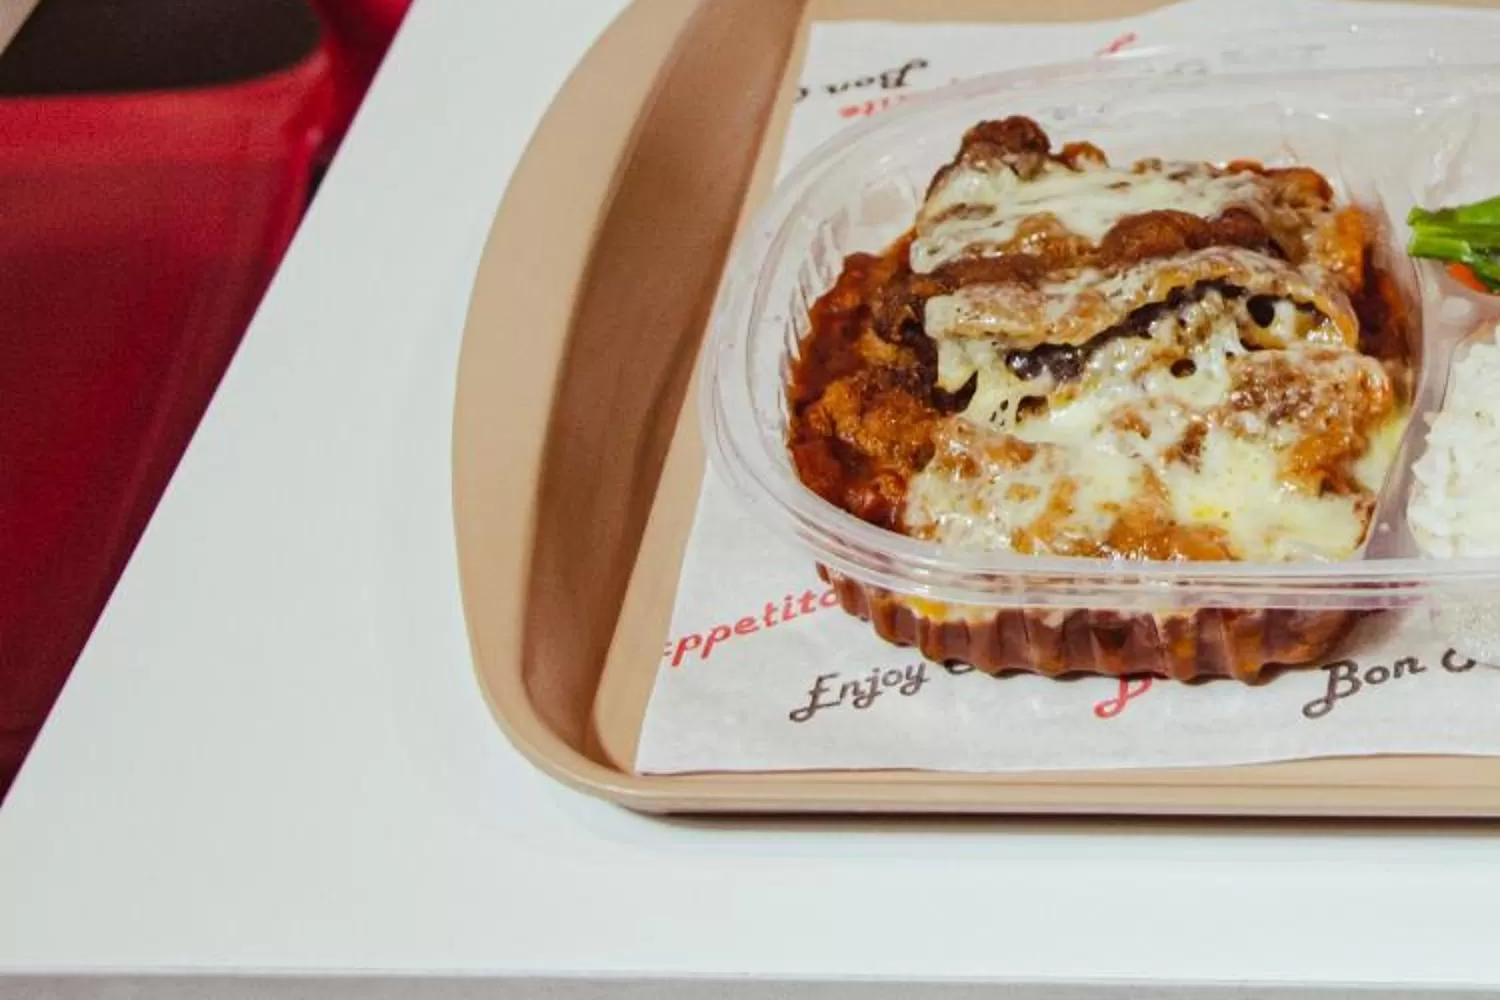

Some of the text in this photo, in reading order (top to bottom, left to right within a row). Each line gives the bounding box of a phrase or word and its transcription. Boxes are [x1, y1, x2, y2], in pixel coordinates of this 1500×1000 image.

[663, 588, 840, 668] ppetito
[788, 661, 931, 723] Enjoy
[1302, 659, 1429, 720] Bon
